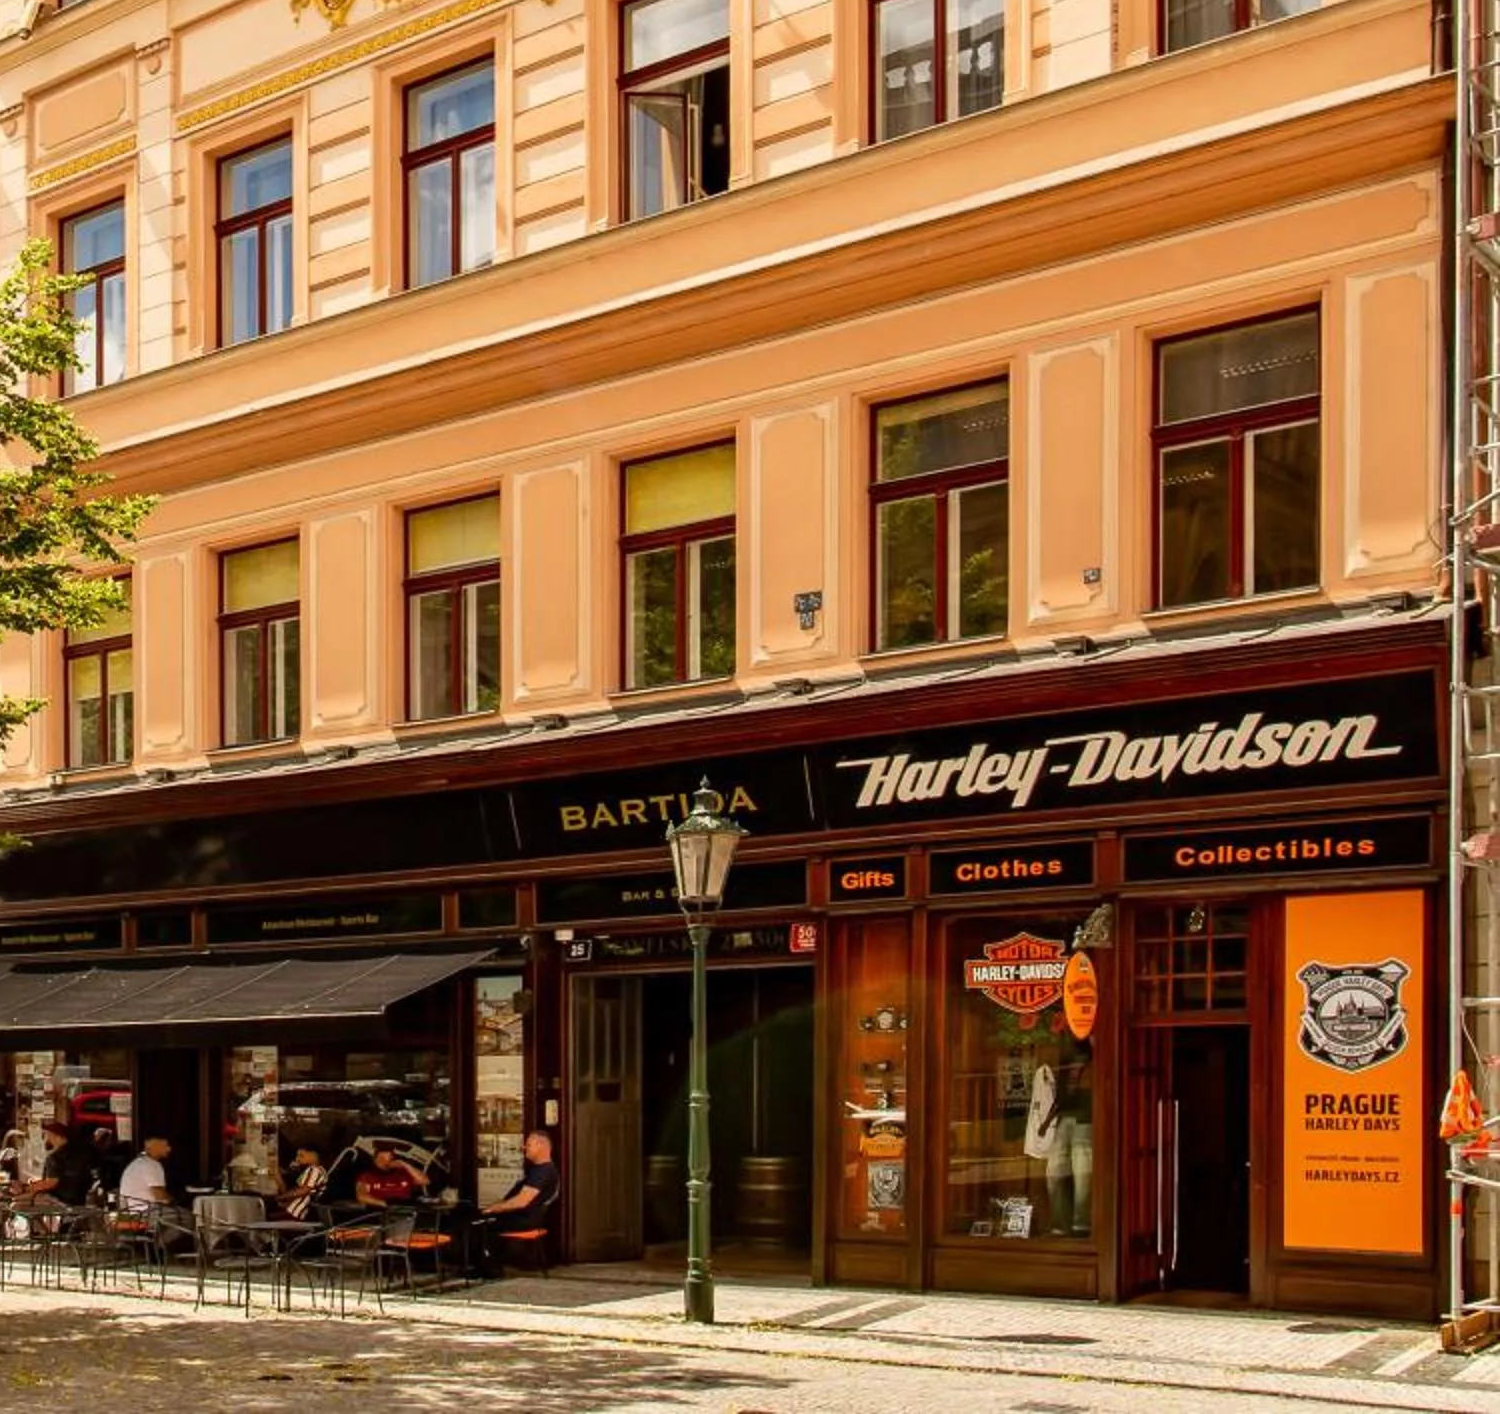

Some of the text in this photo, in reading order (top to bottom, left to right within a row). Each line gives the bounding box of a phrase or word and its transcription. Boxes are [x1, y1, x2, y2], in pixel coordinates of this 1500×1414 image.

[836, 713, 1403, 808] Harley-Davidson
[1175, 837, 1377, 867] Collectibles
[841, 869, 895, 890] Gifts
[955, 856, 1063, 882] Clothes
[1305, 1093, 1400, 1115] PRAGUE
[1305, 1118, 1400, 1131] HARLEY DAYS
[1305, 1170, 1399, 1183] HARLEYDAYS.CZ
